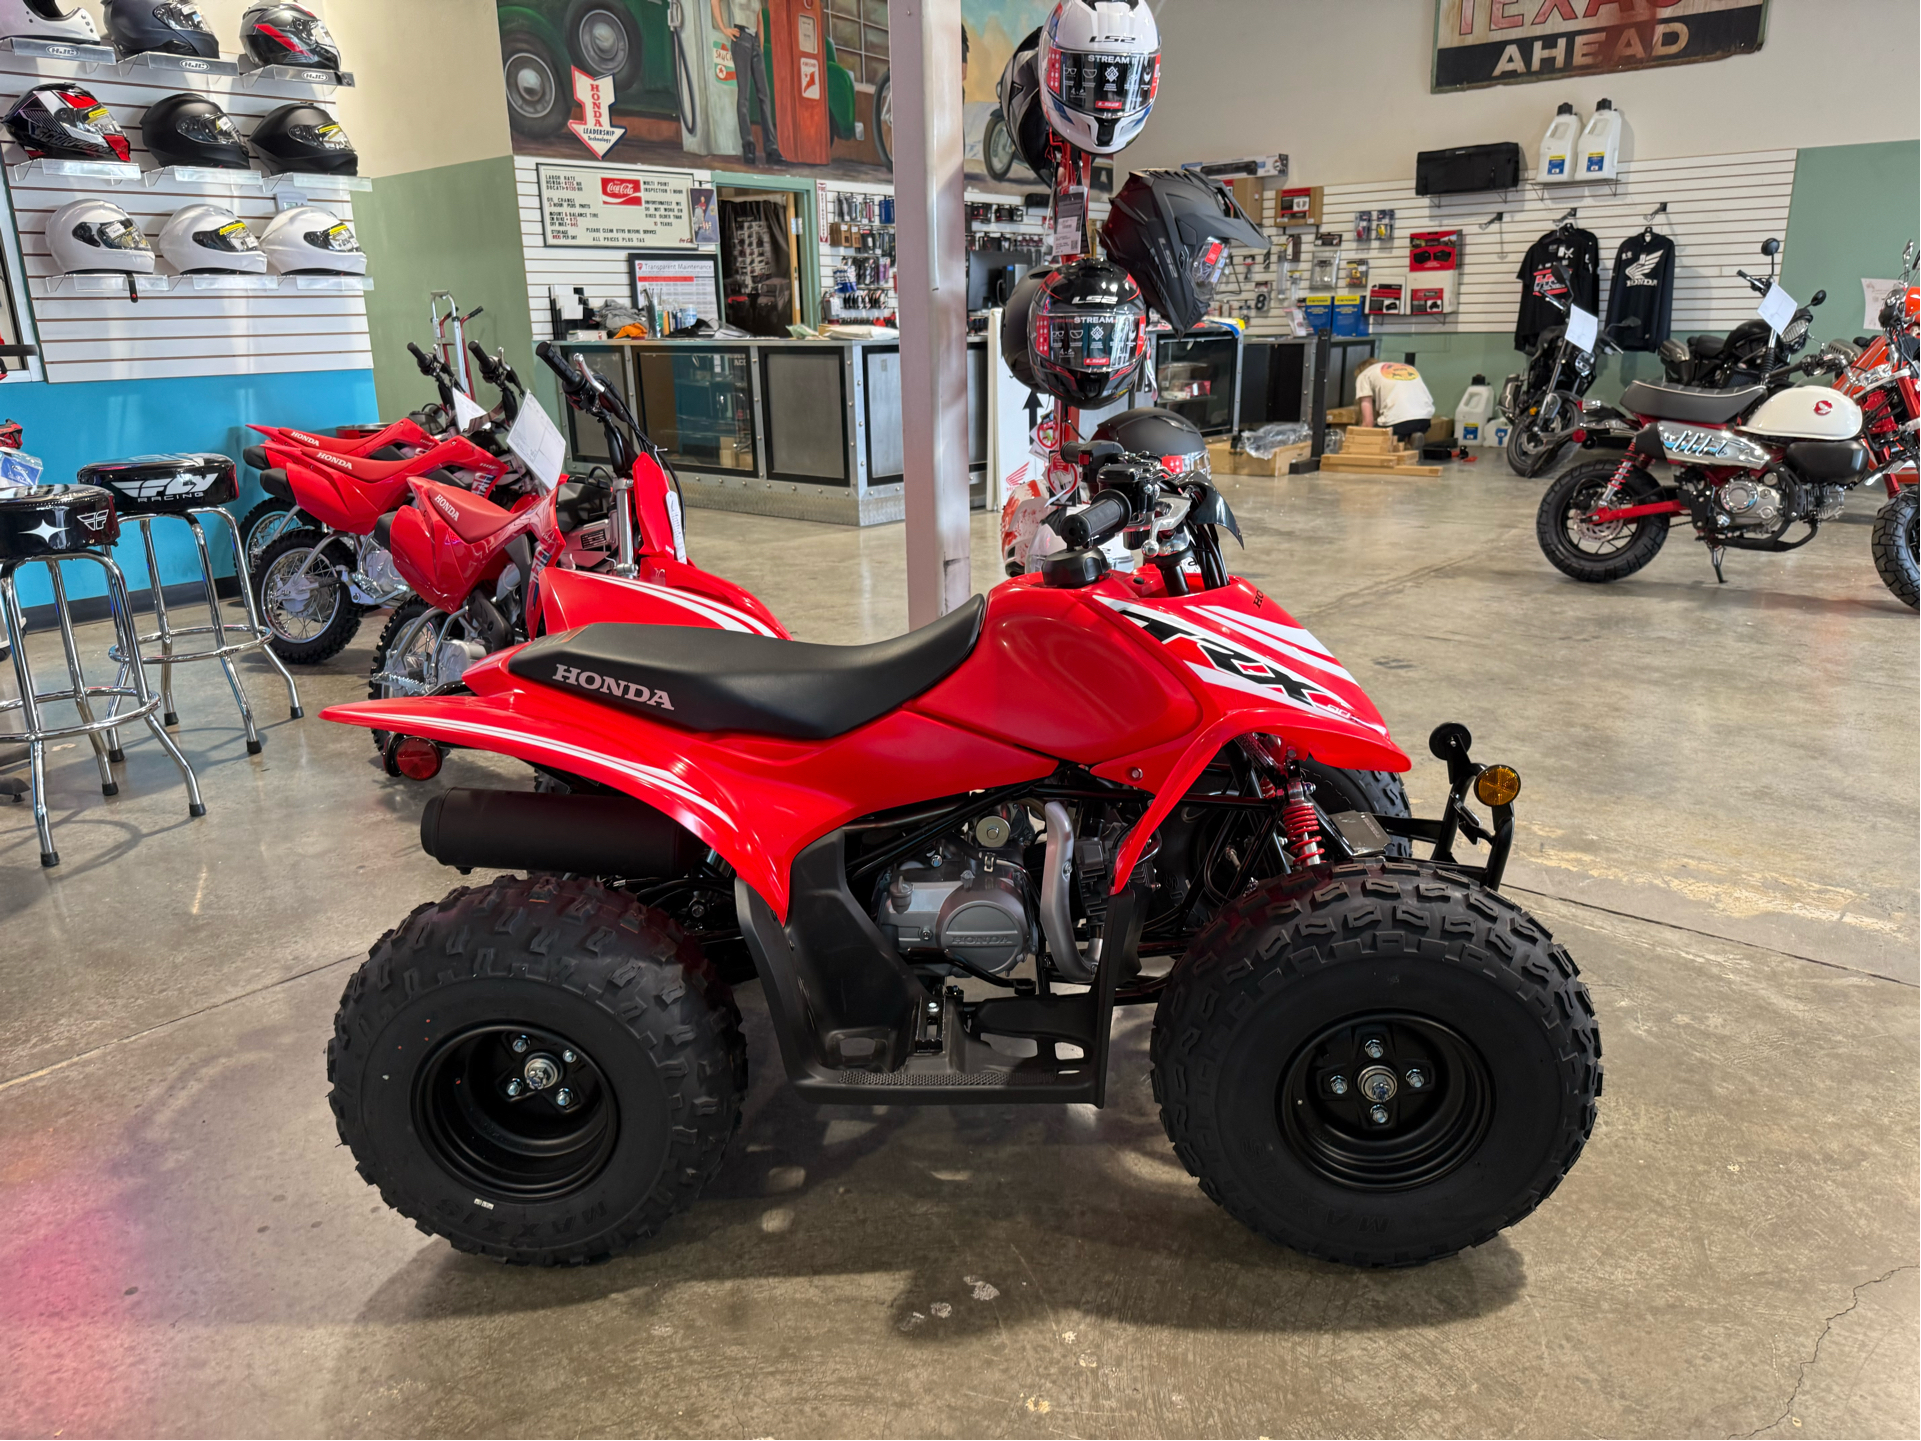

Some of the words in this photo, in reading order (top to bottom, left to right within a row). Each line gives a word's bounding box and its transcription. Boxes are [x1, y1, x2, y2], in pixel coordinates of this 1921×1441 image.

[1089, 36, 1136, 44] LS2
[50, 46, 76, 55] HJC
[1491, 22, 1689, 77] AHEAD
[1088, 55, 1130, 64] STREAM
[184, 61, 207, 70] HJC
[304, 72, 327, 81] HJC
[590, 84, 604, 128] HONDA
[583, 128, 616, 137] LEADERSHIP
[588, 136, 612, 144] Technology
[1626, 278, 1658, 287] HONDA
[1072, 296, 1118, 304] LS2
[290, 431, 320, 447] HONDA
[316, 452, 352, 470] HONDA
[111, 473, 219, 498] FLY
[138, 492, 204, 502] RACING
[434, 494, 460, 522] HONDA
[552, 664, 674, 710] HONDA
[952, 936, 1013, 945] HONDA
